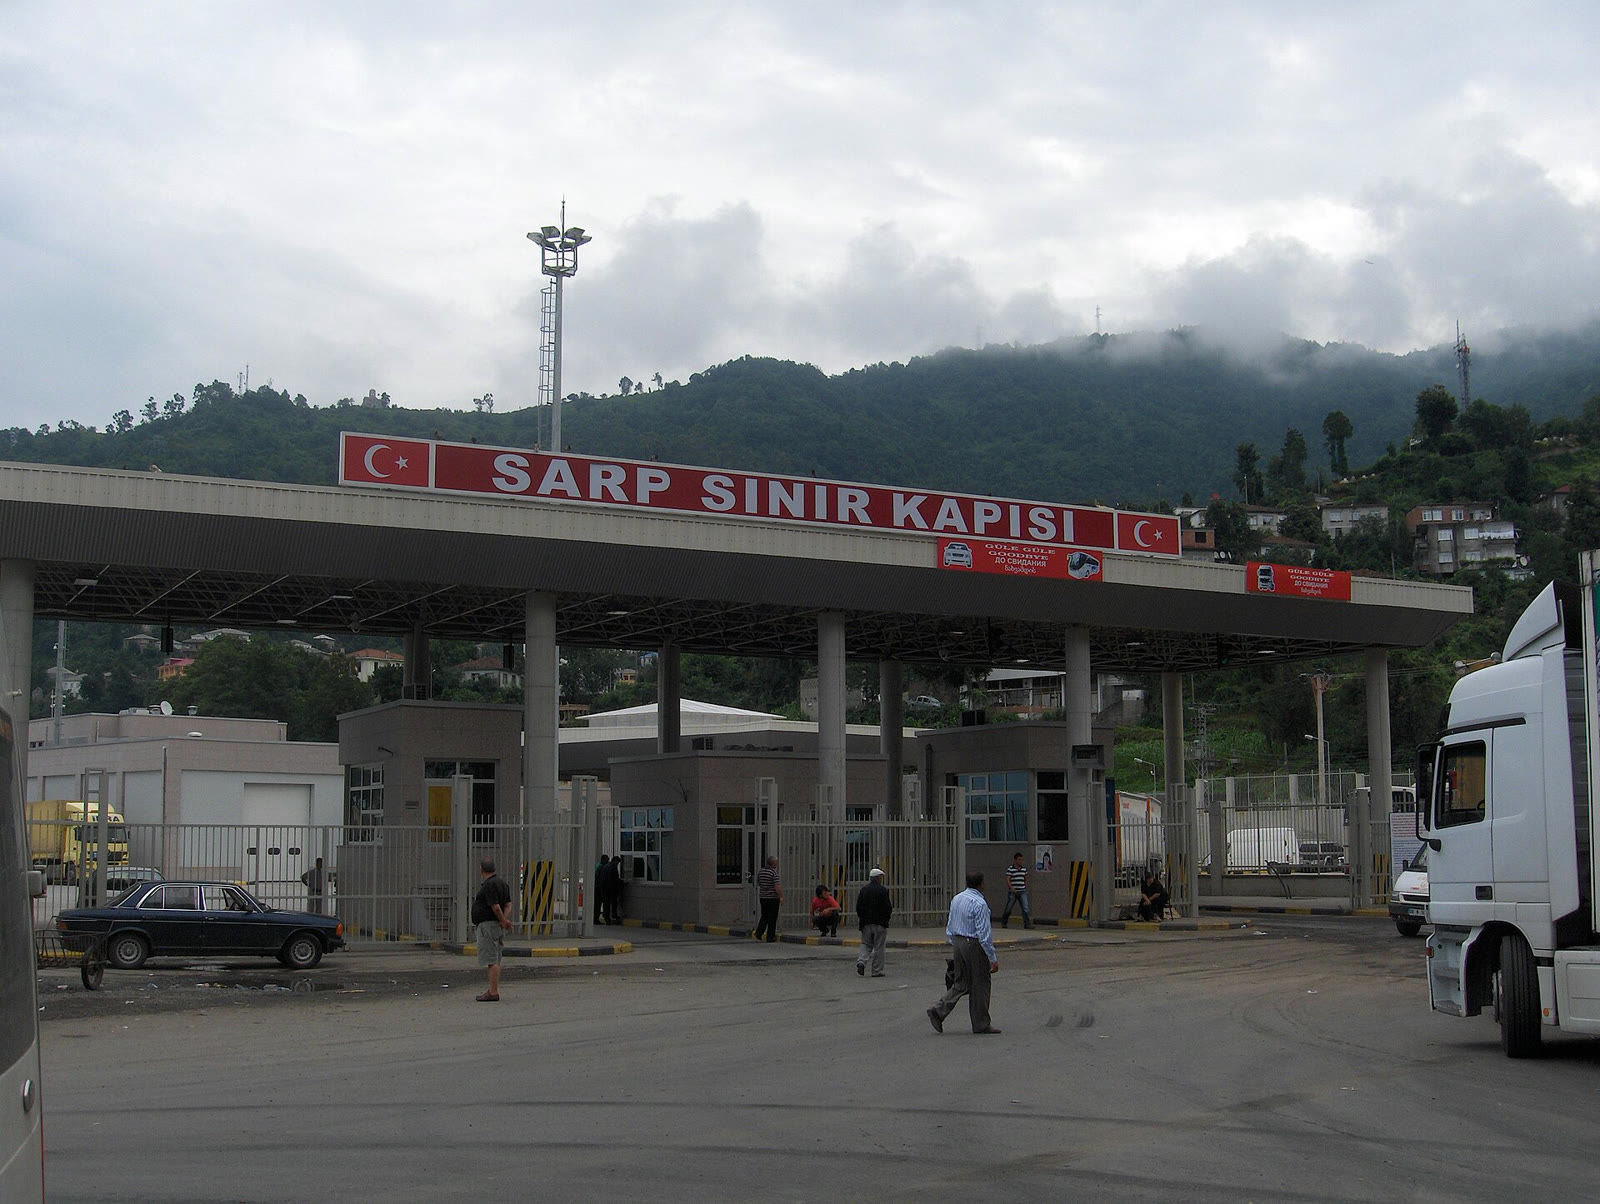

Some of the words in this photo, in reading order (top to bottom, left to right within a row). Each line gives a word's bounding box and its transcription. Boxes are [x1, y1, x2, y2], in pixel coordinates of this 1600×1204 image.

[491, 453, 671, 504] SARP
[701, 474, 873, 524] SINIR
[892, 493, 1075, 543] KAPISI
[985, 543, 1019, 551] GÜLE
[988, 550, 1049, 561] GOODBYE
[1007, 558, 1047, 567] СВИДАНИЯ
